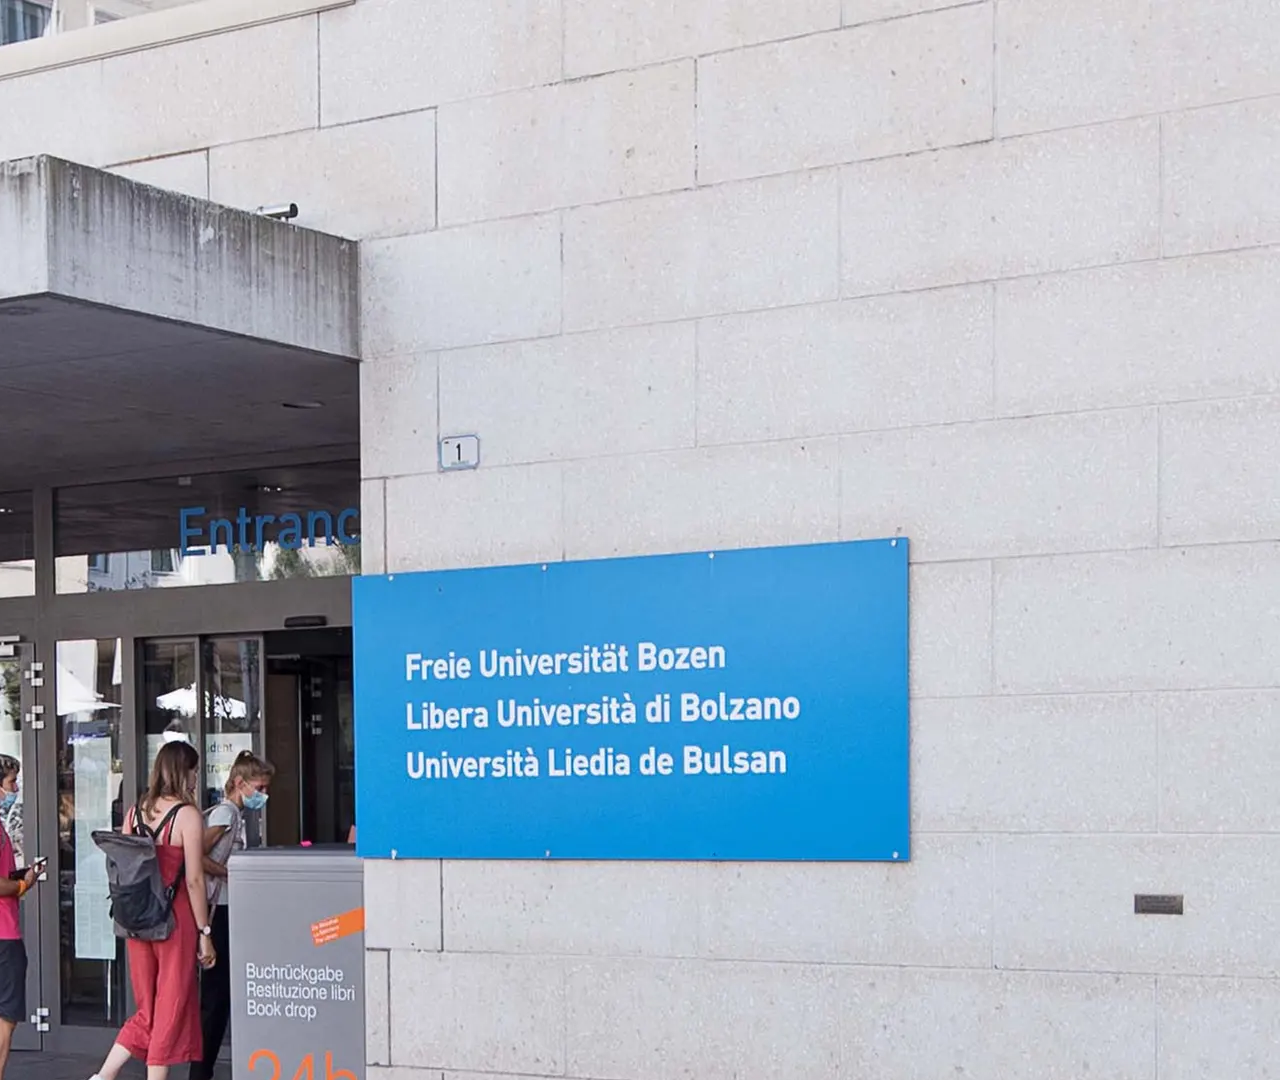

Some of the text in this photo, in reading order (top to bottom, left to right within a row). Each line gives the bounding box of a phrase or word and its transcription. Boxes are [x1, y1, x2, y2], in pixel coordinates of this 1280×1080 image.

[456, 443, 461, 461] 1
[180, 506, 361, 556] Entranc
[406, 641, 726, 681] Freie Universität Bozen
[406, 692, 801, 730] Libera Università di Bolzano
[406, 744, 787, 779] Università Liedia de Bulsan
[246, 962, 344, 985] Buchrückgabe
[246, 981, 356, 1001] Restituzione libri
[247, 999, 317, 1022] Book drop
